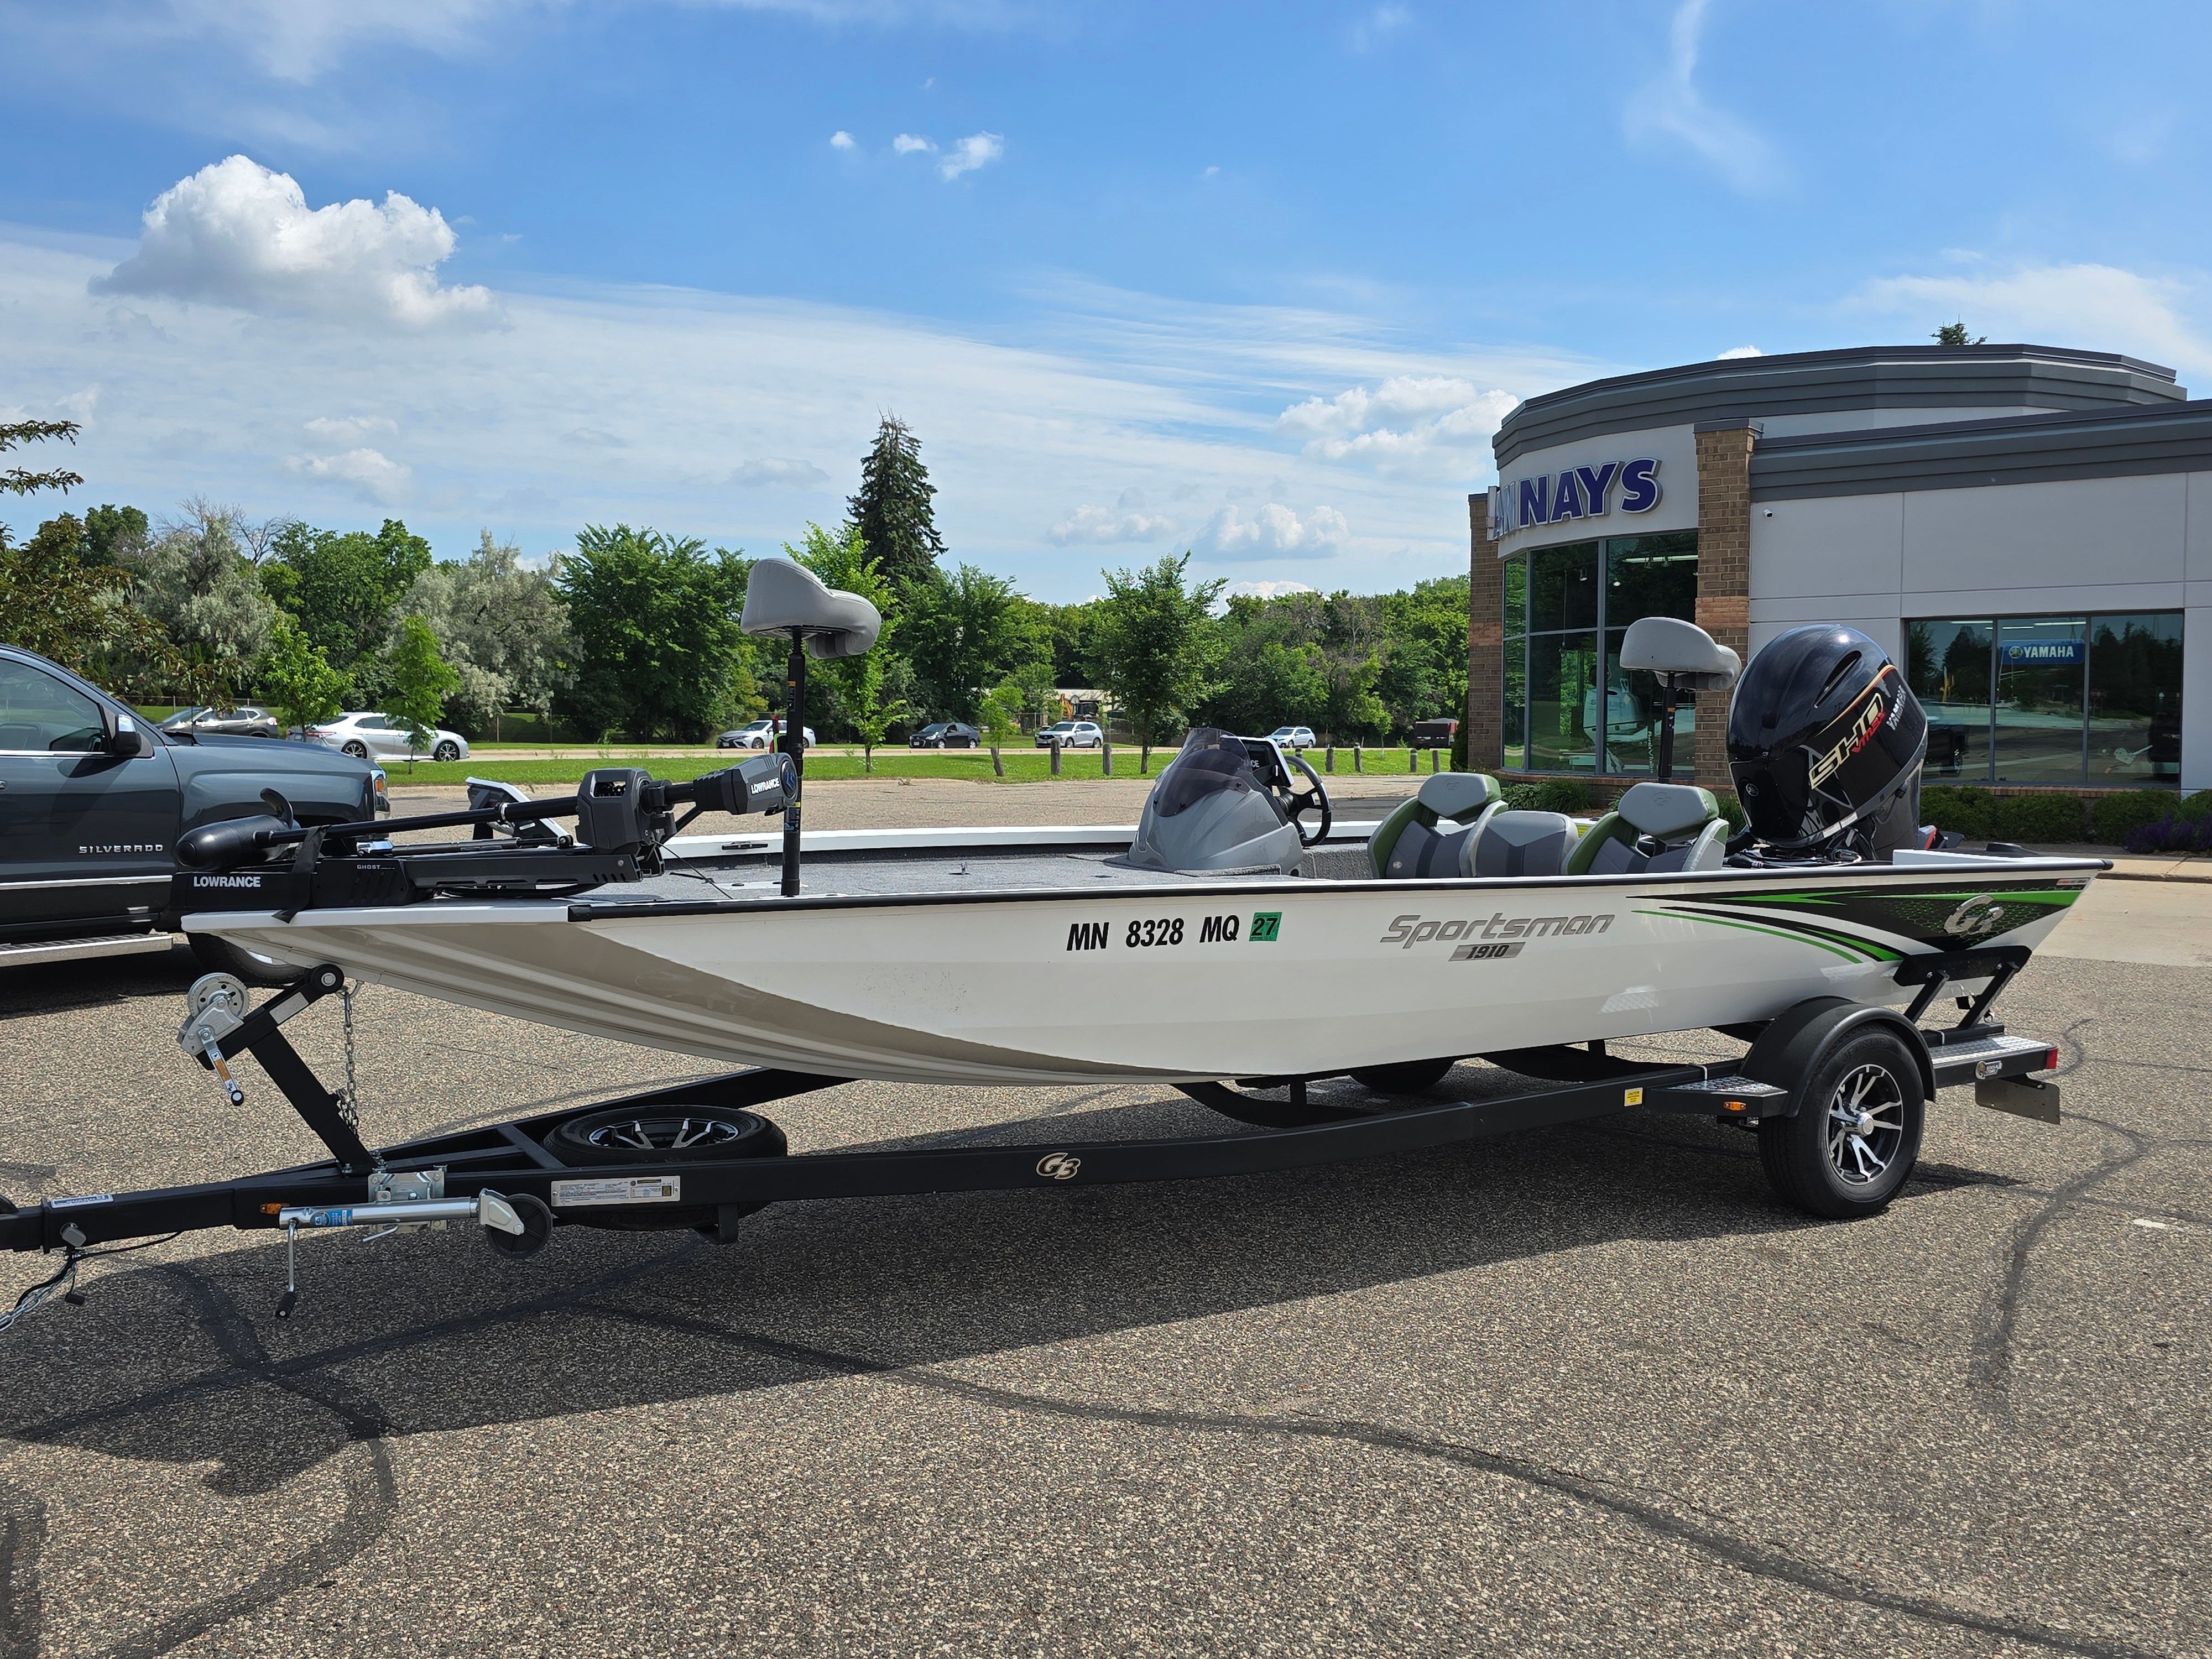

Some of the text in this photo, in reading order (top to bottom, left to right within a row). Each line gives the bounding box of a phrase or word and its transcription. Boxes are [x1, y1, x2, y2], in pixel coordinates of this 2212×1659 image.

[2023, 645, 2074, 658] YAMAHA
[1590, 699, 1627, 708] SUKI
[1886, 685, 1907, 731] YAMAHA
[1809, 692, 1884, 790] SHO
[750, 777, 780, 794] LOWRANCE
[79, 844, 164, 854] SILVERADO
[194, 876, 261, 888] LOWRANCE
[1066, 915, 1239, 951] MN 8328 MQ
[1251, 917, 1279, 936] 27
[1380, 912, 1615, 949] Sportsman
[1465, 945, 1510, 959] 1910
[1036, 1152, 1081, 1180] G3
